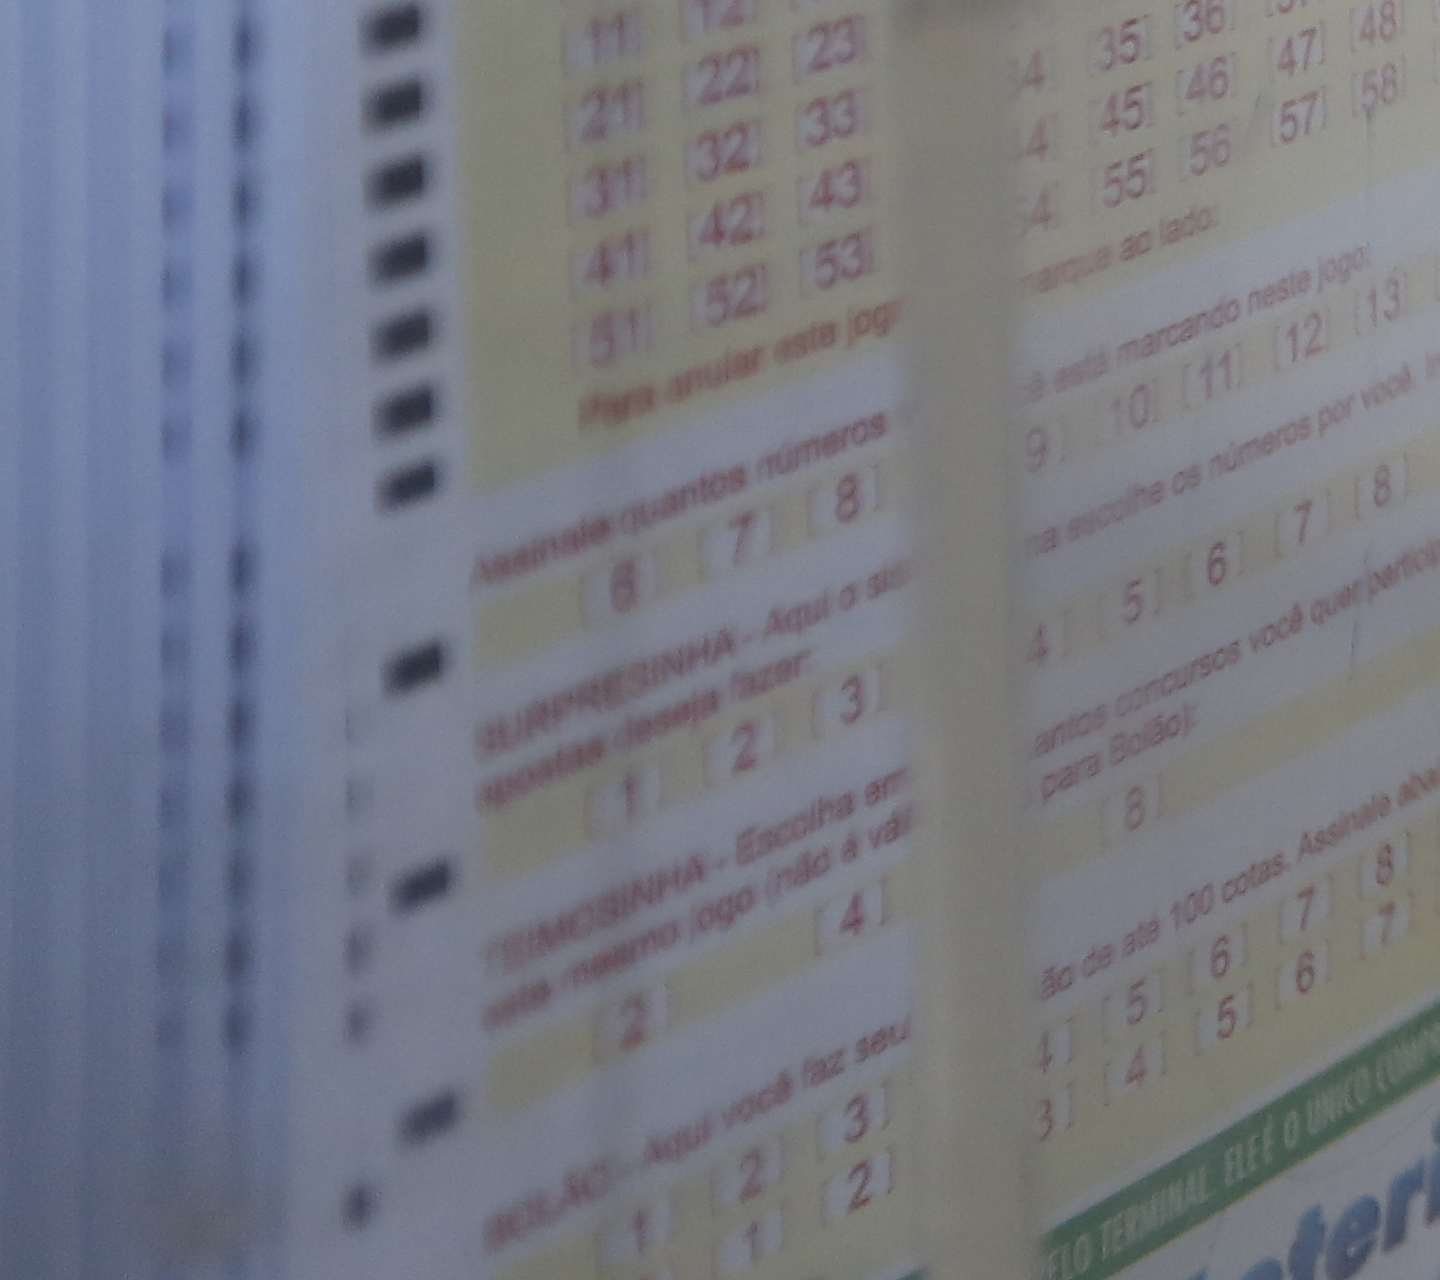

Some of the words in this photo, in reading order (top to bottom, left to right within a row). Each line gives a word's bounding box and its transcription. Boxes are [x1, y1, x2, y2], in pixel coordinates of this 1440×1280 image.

[1119, 228, 1151, 262] ao
[1117, 297, 1241, 369] marcando
[1246, 268, 1311, 316] neste
[1172, 463, 1203, 496] os
[1208, 415, 1311, 479] números
[1317, 393, 1356, 437] por
[1114, 640, 1242, 718] concursos
[1248, 601, 1306, 654] você
[1310, 580, 1363, 627] quer
[722, 1067, 795, 1129] você
[1081, 942, 1117, 979] de
[1122, 913, 1161, 958] até
[1169, 882, 1215, 930] 100
